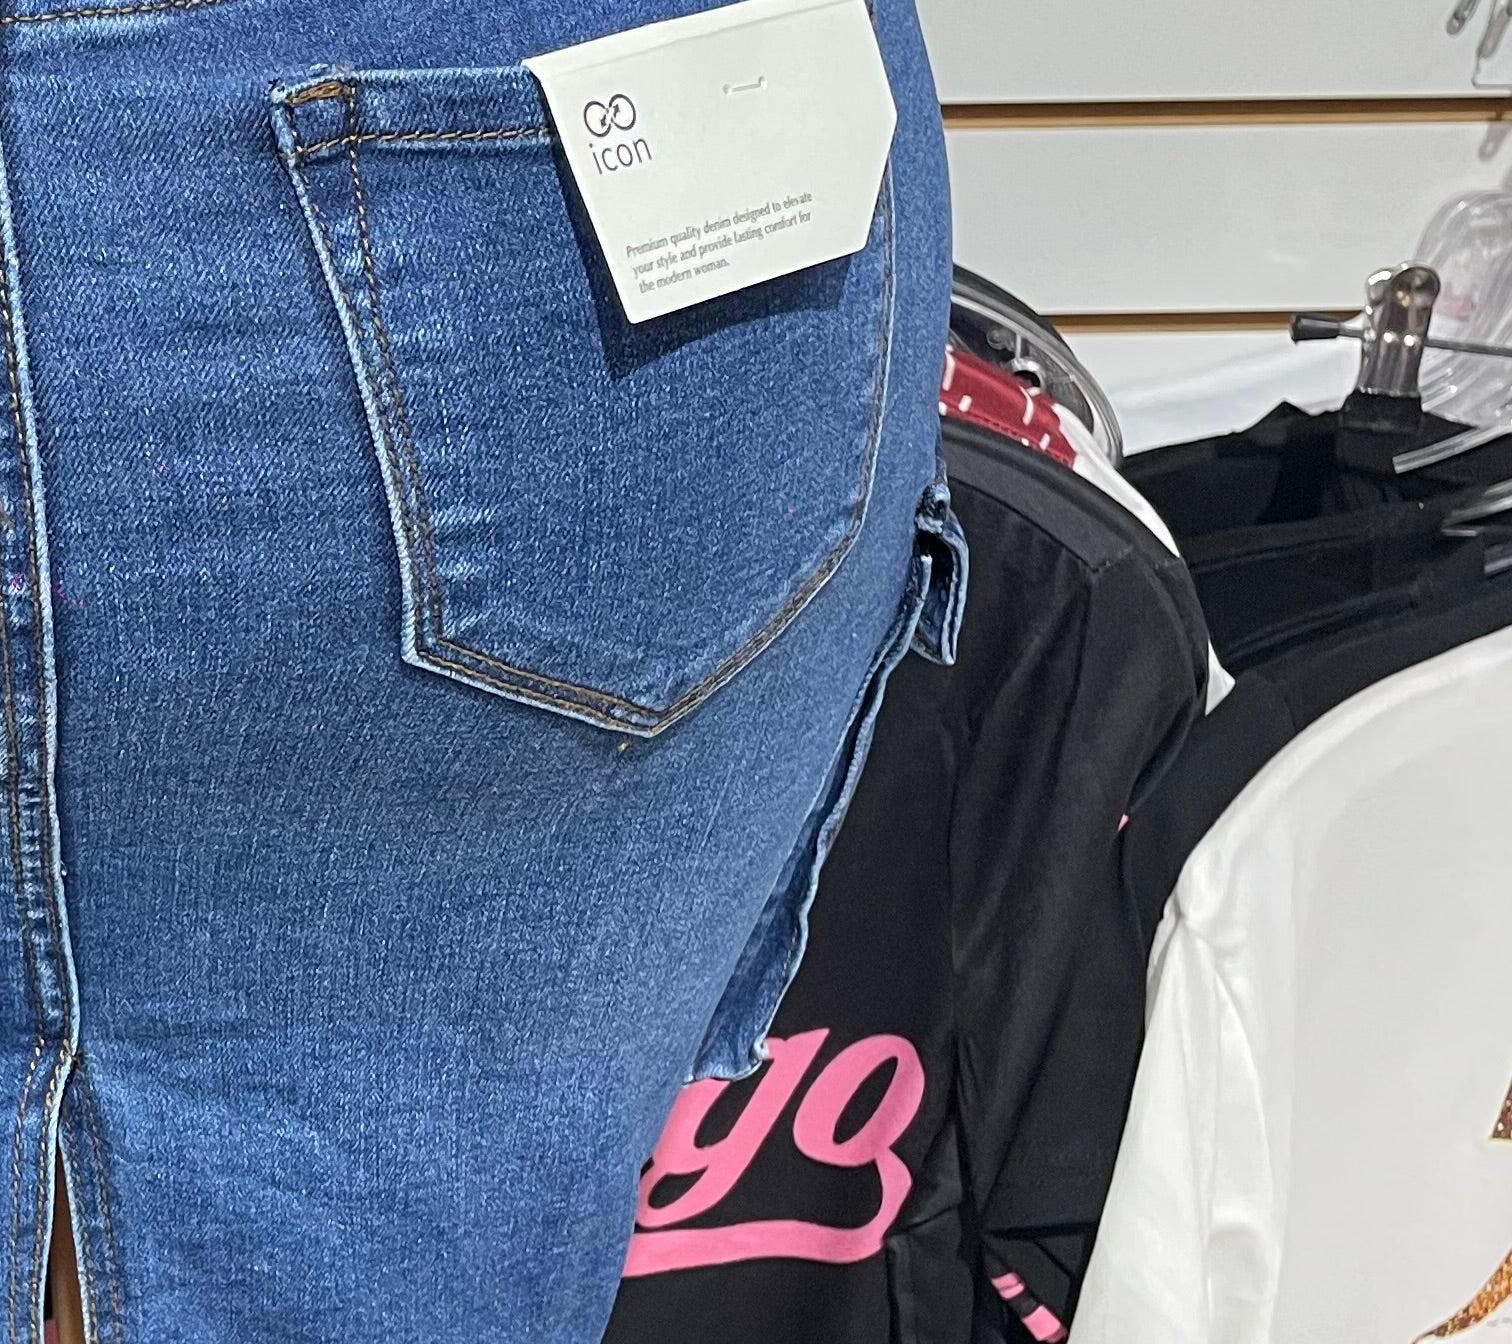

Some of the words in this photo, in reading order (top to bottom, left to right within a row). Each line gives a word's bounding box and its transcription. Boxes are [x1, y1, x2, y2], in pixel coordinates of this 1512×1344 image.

[589, 136, 652, 175] icon
[626, 237, 669, 258] Premium
[670, 225, 702, 247] quality
[703, 216, 732, 234] denim
[733, 202, 771, 225] designed
[772, 200, 782, 213] to
[782, 192, 813, 210] elevate
[632, 261, 654, 280] your
[656, 251, 678, 271] style
[680, 244, 697, 261] and
[698, 234, 733, 259] provide
[733, 225, 764, 244] lasting
[764, 214, 798, 234] comfort
[798, 210, 811, 224] for
[639, 279, 655, 294] the
[656, 267, 692, 288] modern
[693, 257, 730, 276] woman.
